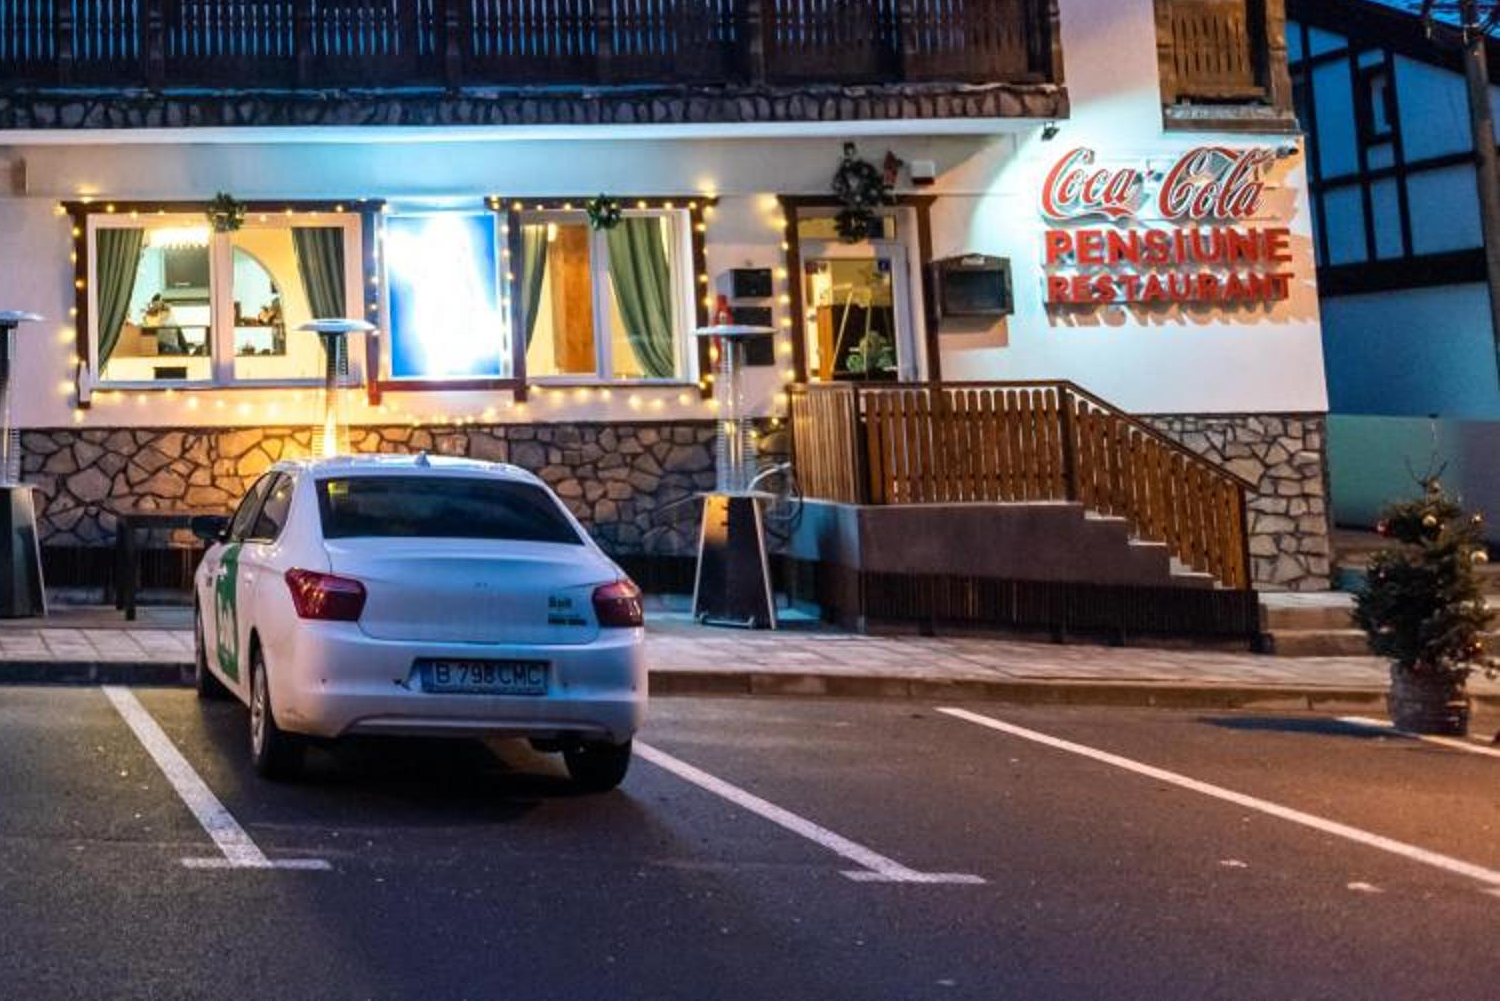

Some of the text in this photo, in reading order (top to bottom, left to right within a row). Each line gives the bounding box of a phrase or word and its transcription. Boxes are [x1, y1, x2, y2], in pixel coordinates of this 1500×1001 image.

[1044, 227, 1293, 265] PENSIUNE
[1046, 271, 1295, 303] RESTAURANT
[436, 662, 451, 685] B
